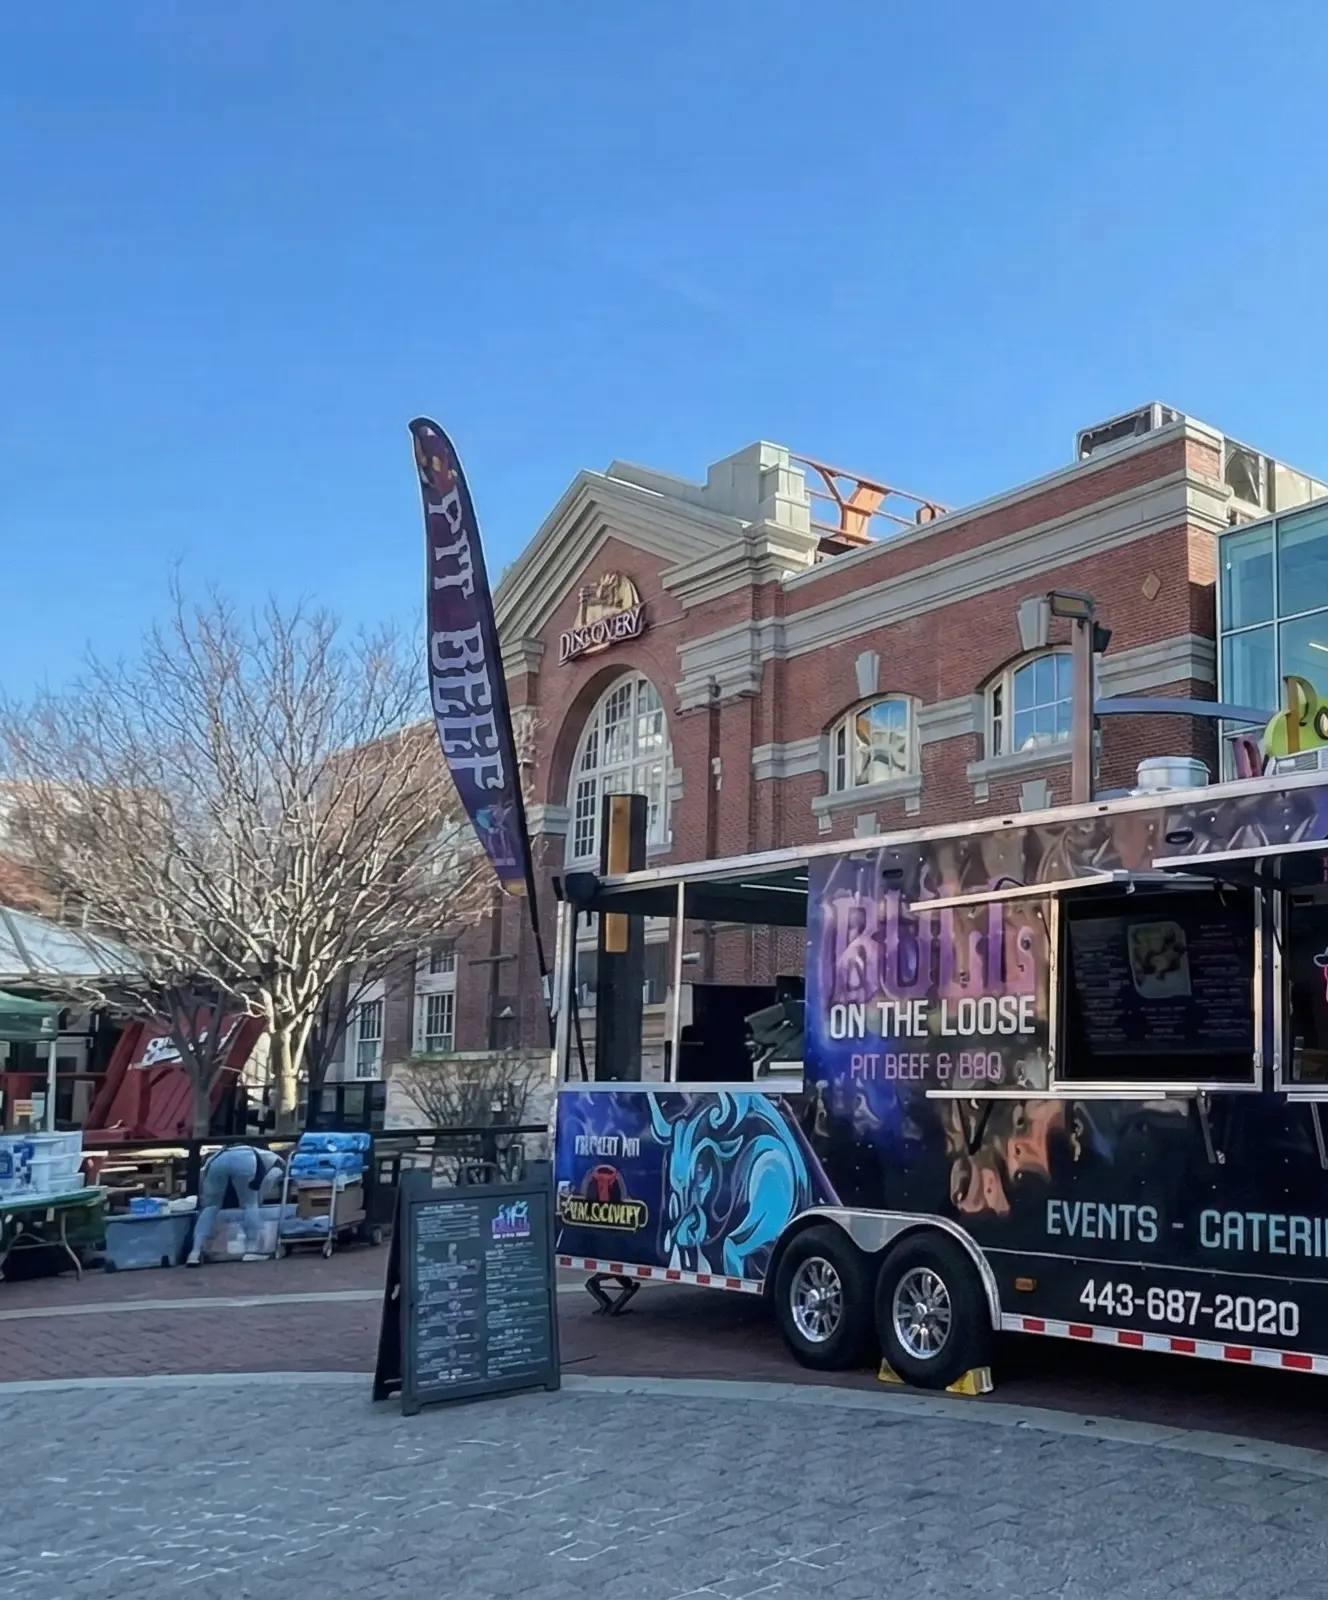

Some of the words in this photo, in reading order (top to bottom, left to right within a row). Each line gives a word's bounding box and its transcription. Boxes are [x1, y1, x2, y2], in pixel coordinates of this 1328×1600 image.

[428, 486, 477, 600] PIT
[431, 621, 506, 792] BEEF
[828, 866, 1036, 1002] BULL
[830, 1003, 865, 1039] ON
[877, 1000, 928, 1037] THE
[940, 996, 1035, 1035] LOOSE
[851, 1054, 880, 1079] PIT
[885, 1053, 929, 1079] BEEF
[936, 1052, 952, 1079] &
[1047, 1199, 1158, 1243] EVENTS
[1079, 1279, 1299, 1337] 443-687-2020
